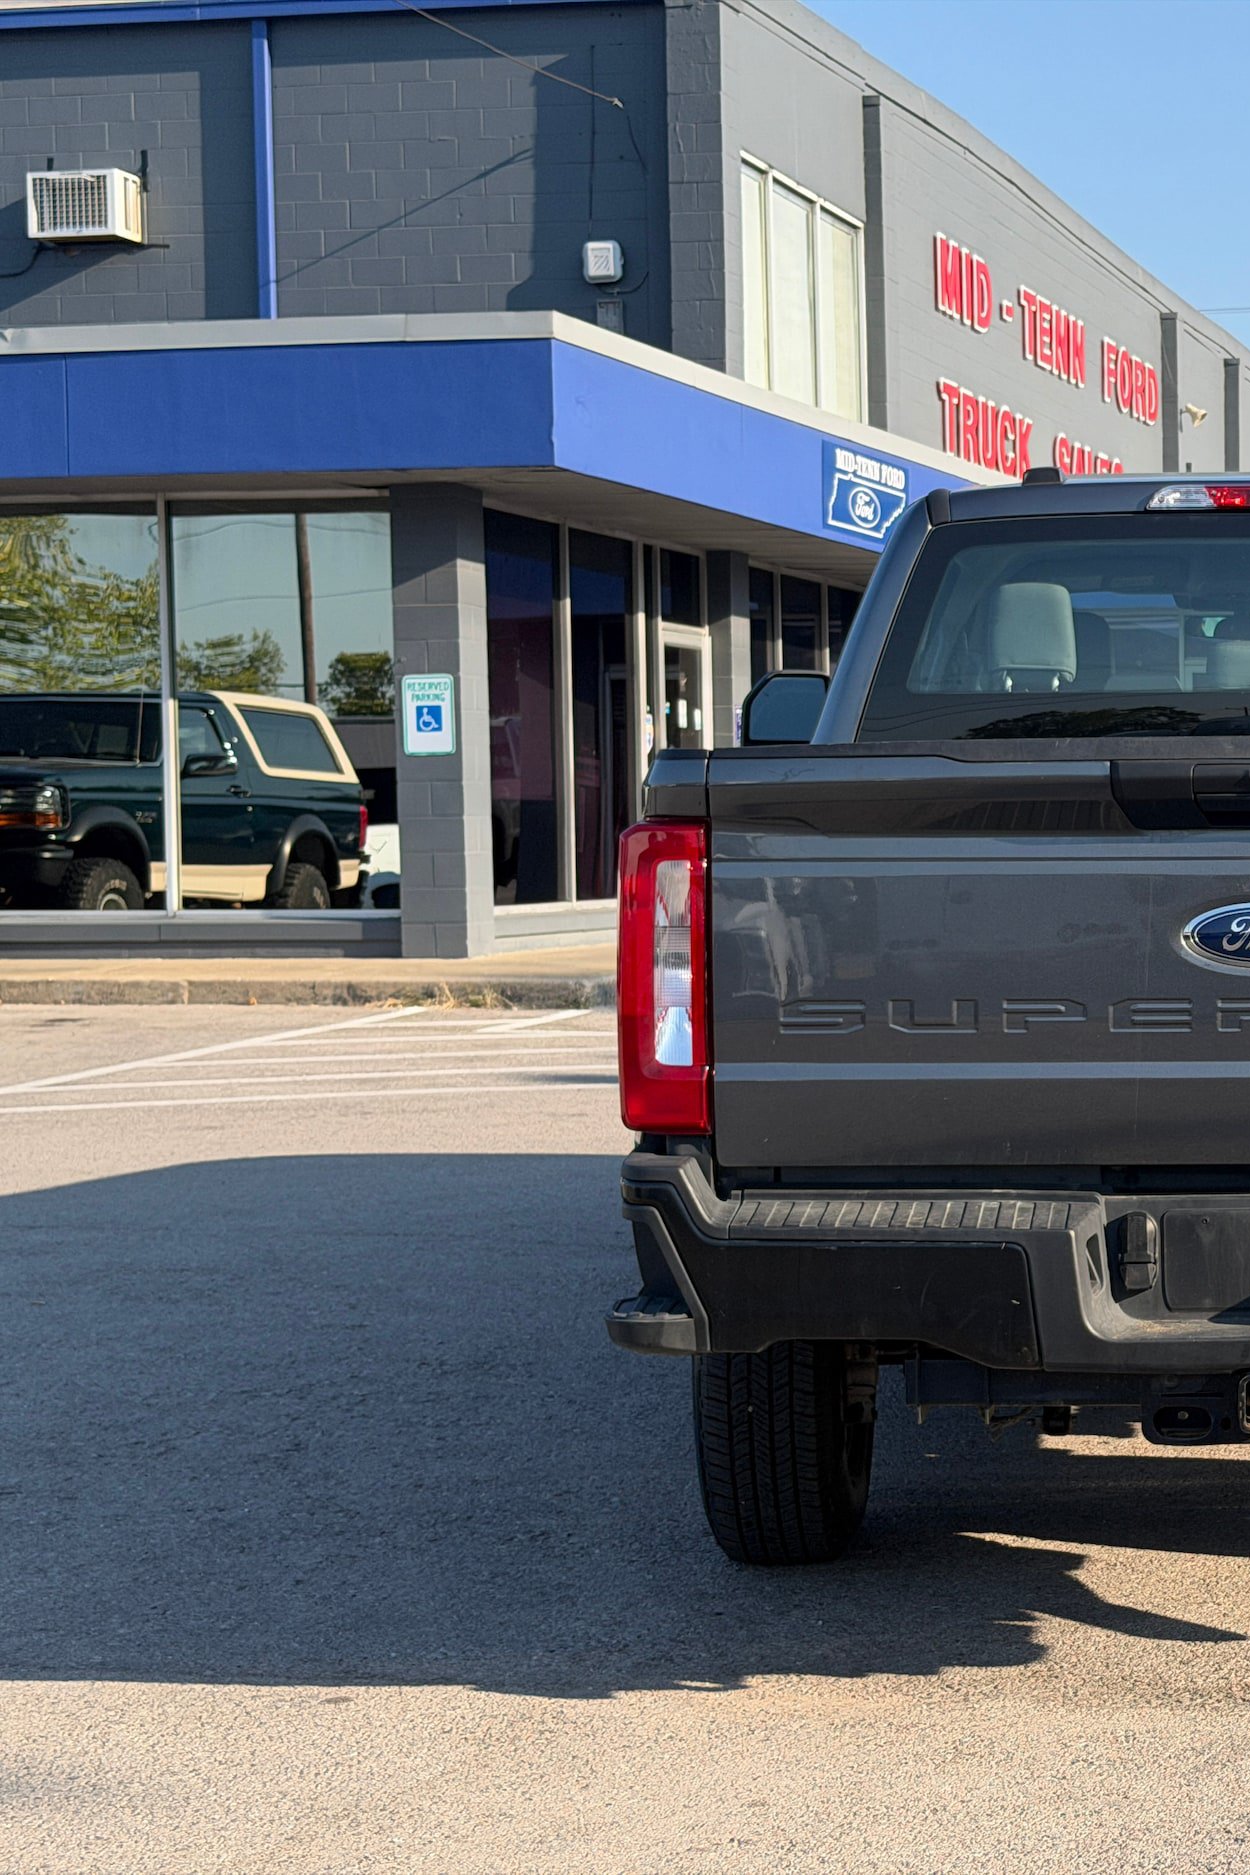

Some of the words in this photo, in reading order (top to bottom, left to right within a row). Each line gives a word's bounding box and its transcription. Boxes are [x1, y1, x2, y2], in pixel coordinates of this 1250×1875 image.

[934, 231, 993, 334] MID
[1018, 284, 1086, 388] TENN
[1102, 336, 1160, 426] FORD
[937, 376, 1033, 480] TRUCK
[881, 463, 906, 490] FORD
[407, 681, 449, 692] RESERVED
[411, 692, 446, 702] PARKING
